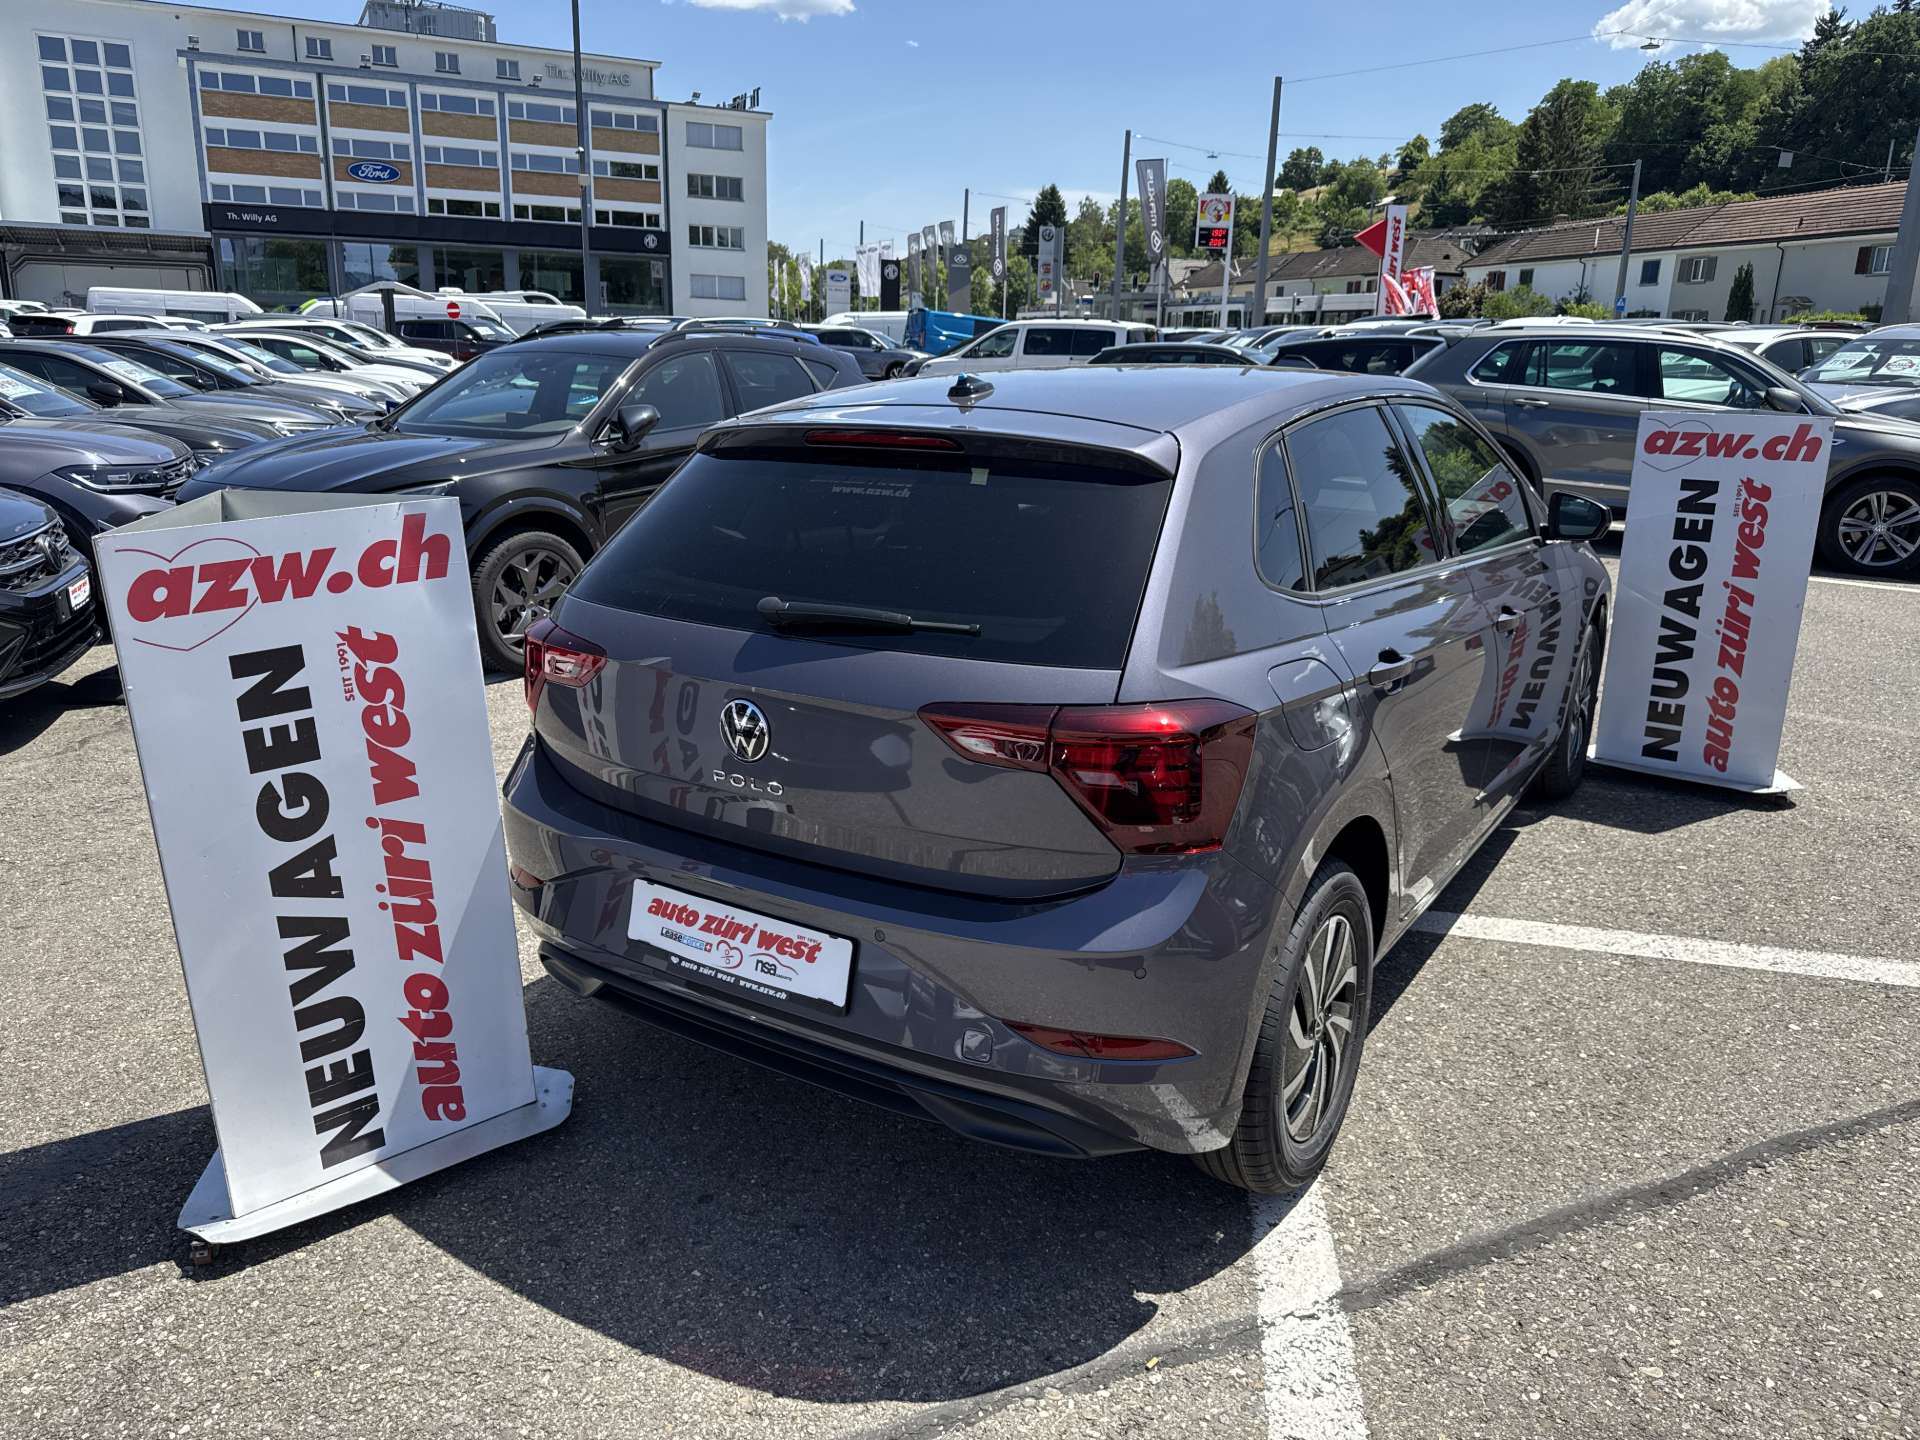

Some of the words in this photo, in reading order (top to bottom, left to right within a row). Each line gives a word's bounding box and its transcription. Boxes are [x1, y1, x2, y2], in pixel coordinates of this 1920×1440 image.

[226, 212, 240, 220] Th.
[241, 213, 263, 223] Willy
[264, 214, 278, 223] AG
[1643, 424, 1823, 463] azw.ch
[1731, 476, 1773, 580] west
[1732, 499, 1741, 517] SEIT
[126, 512, 451, 623] azw.ch
[1641, 478, 1720, 762] NEUWAGEN
[1714, 580, 1755, 678] züri
[337, 641, 350, 671] 1991
[342, 676, 356, 702] SEIT
[336, 625, 421, 806] west
[1703, 676, 1740, 773] auto
[712, 769, 784, 796] POLO
[228, 644, 386, 1170] NEUWAGEN
[364, 816, 444, 964] züri
[647, 897, 700, 928] auto
[698, 914, 758, 945] züri
[757, 927, 823, 964] west
[660, 926, 705, 952] LeaseForce
[680, 959, 698, 972] auto
[716, 971, 735, 985] west
[738, 979, 788, 1001] www.azw.ch
[755, 958, 777, 977] nsa
[397, 972, 467, 1122] auto
